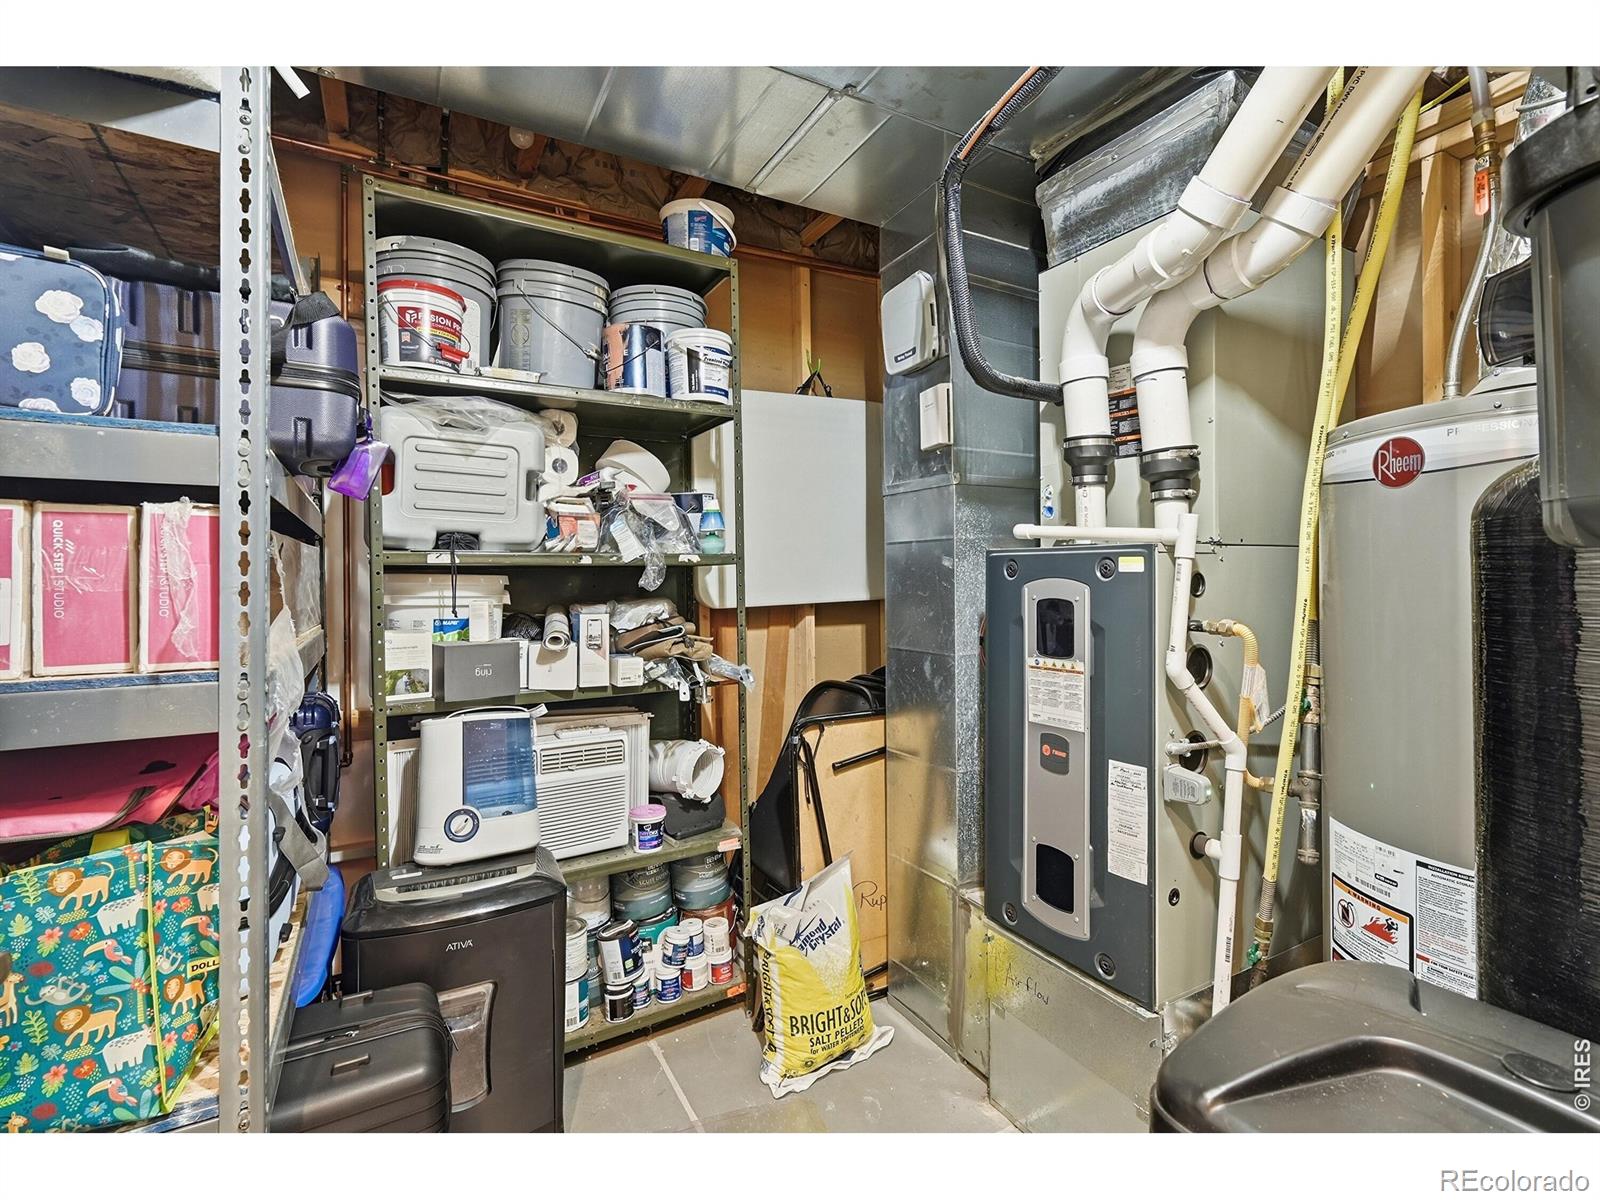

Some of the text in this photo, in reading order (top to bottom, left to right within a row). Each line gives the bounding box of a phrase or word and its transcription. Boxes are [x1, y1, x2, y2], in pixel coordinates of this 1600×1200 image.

[417, 311, 452, 327] FSION
[1378, 440, 1422, 481] Rheem
[53, 579, 65, 619] STUDIO
[159, 580, 170, 618] STUDIO
[474, 667, 493, 678] ring
[1353, 891, 1381, 911] WARNING
[445, 939, 474, 952] ATIVA
[807, 916, 842, 951] Crystal
[809, 1016, 865, 1048] SALT PELLETS
[810, 1047, 820, 1055] for
[821, 1040, 840, 1052] WATER
